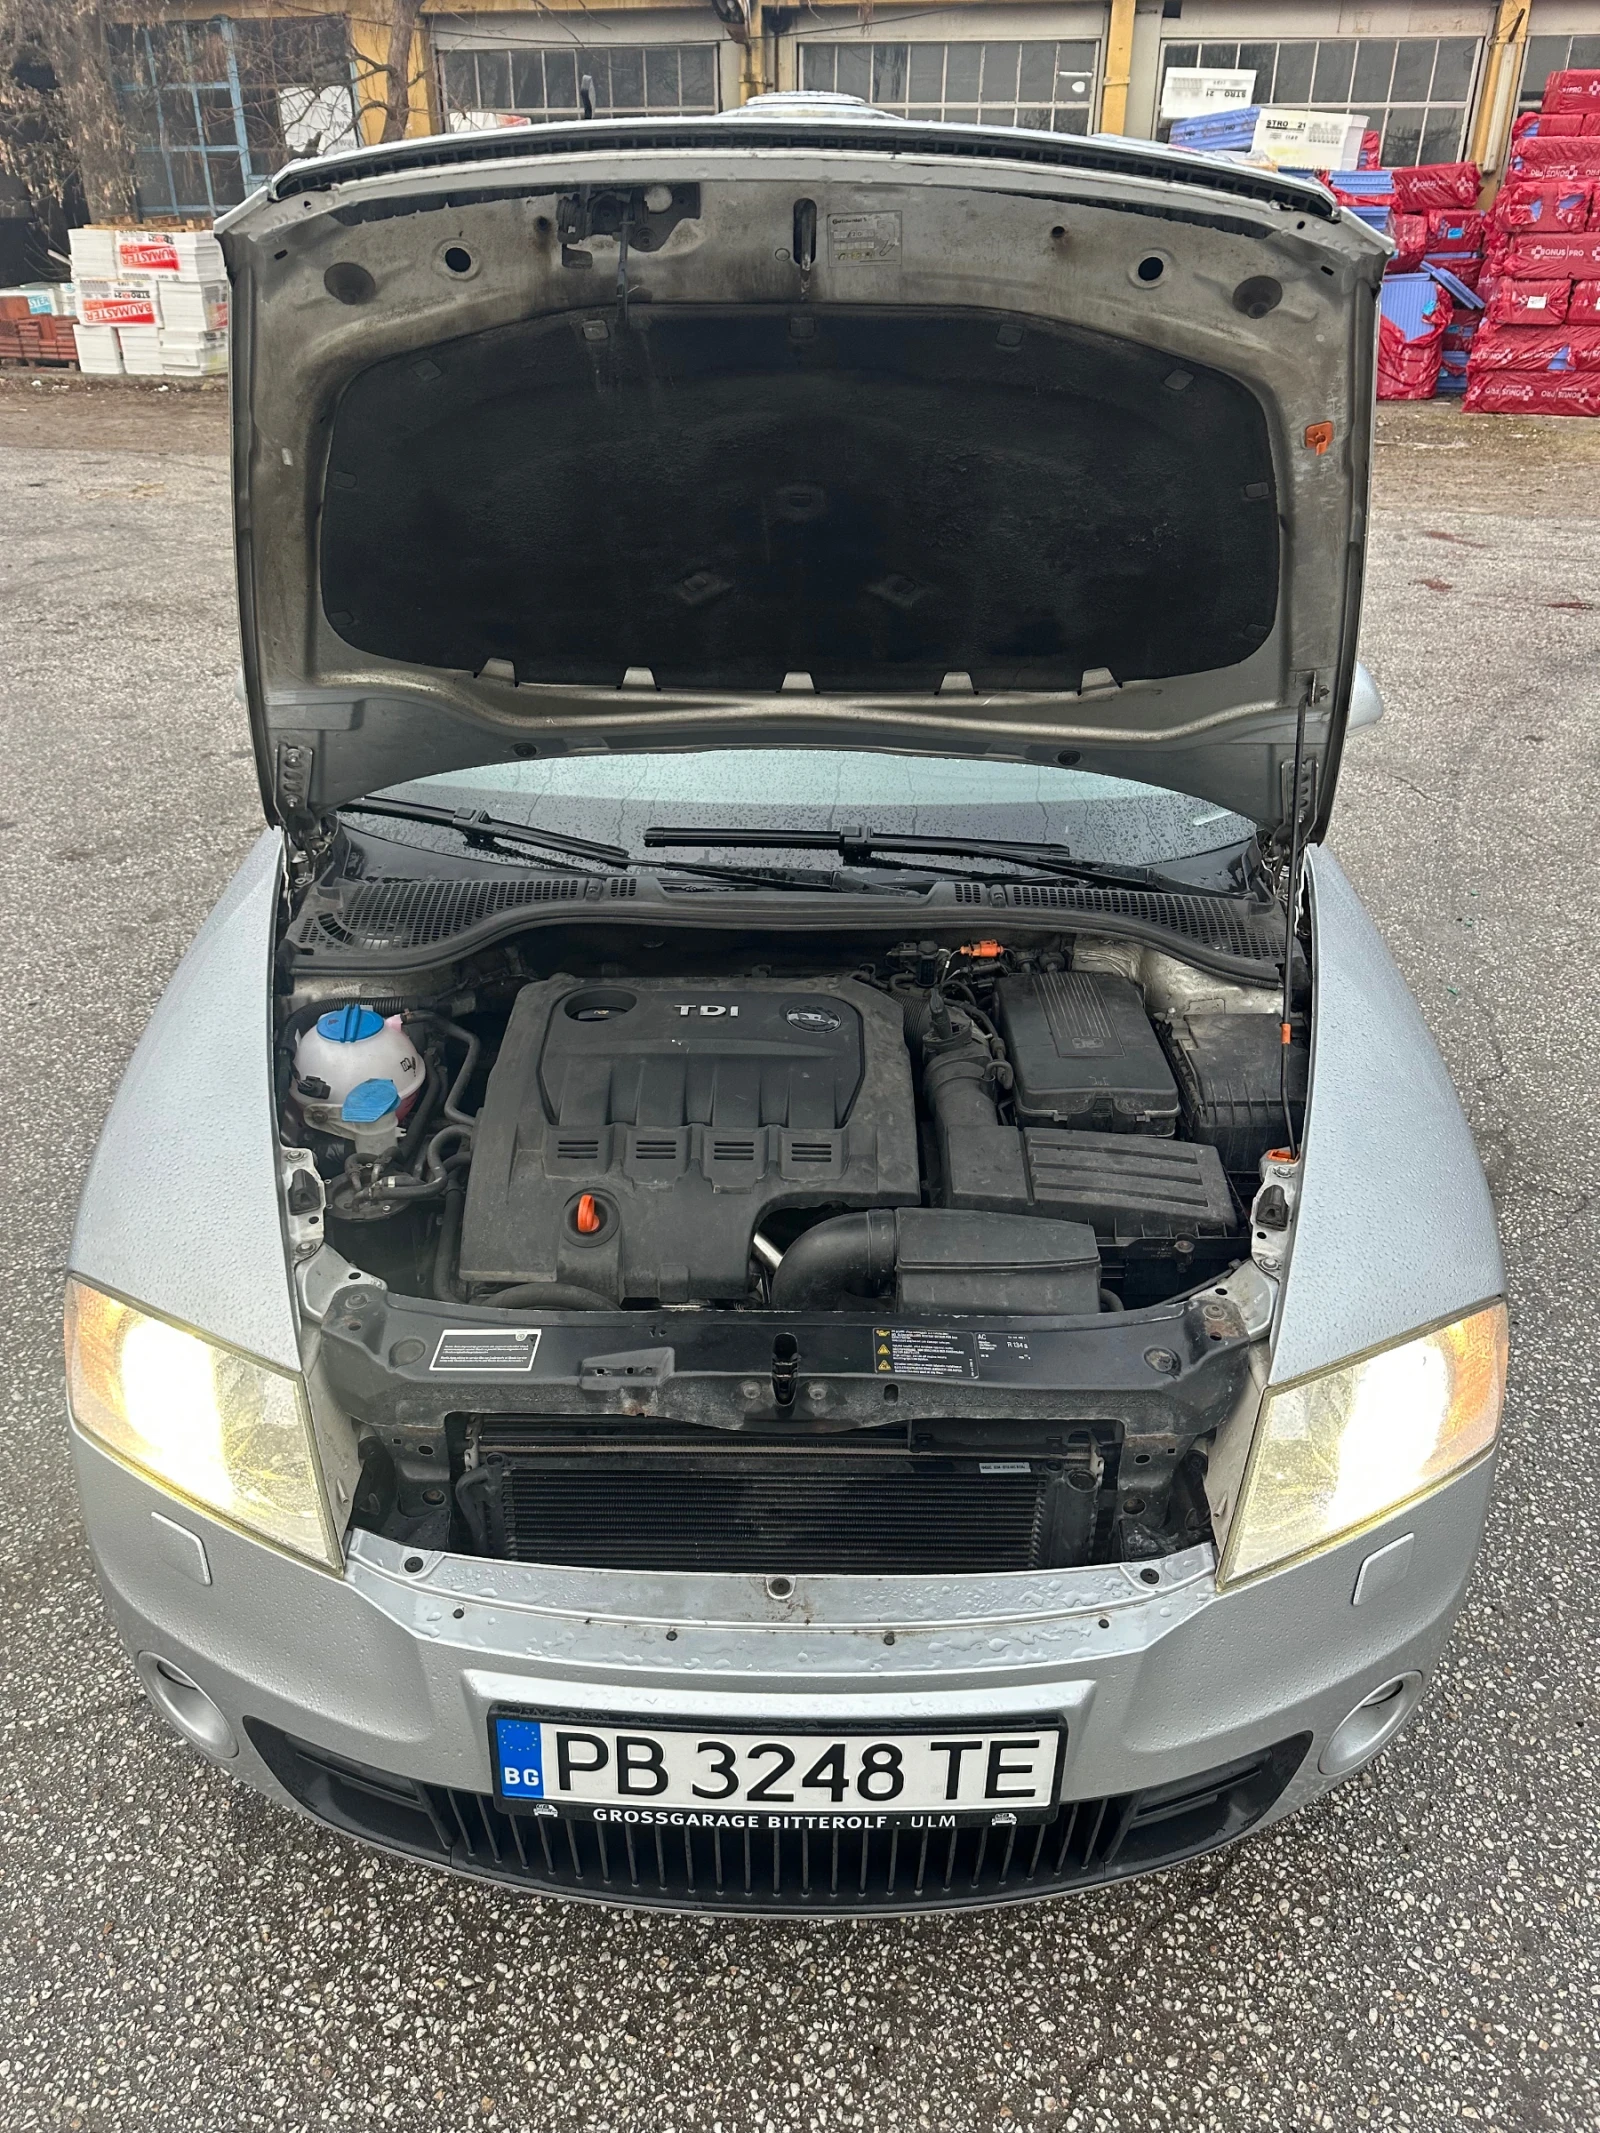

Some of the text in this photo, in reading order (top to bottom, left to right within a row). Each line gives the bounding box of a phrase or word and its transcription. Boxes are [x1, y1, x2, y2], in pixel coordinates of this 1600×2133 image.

[1224, 90, 1246, 98] STRO
[1266, 119, 1289, 128] STRO
[1541, 248, 1584, 257] BONUS PRO
[85, 302, 153, 322] BAUMASTER
[674, 1004, 739, 1017] TDI
[556, 1731, 1040, 1802] PB 3248 TE
[504, 1767, 539, 1786] BG
[592, 1808, 956, 1829] GROSSGARAGE BITTEROLF ULM
